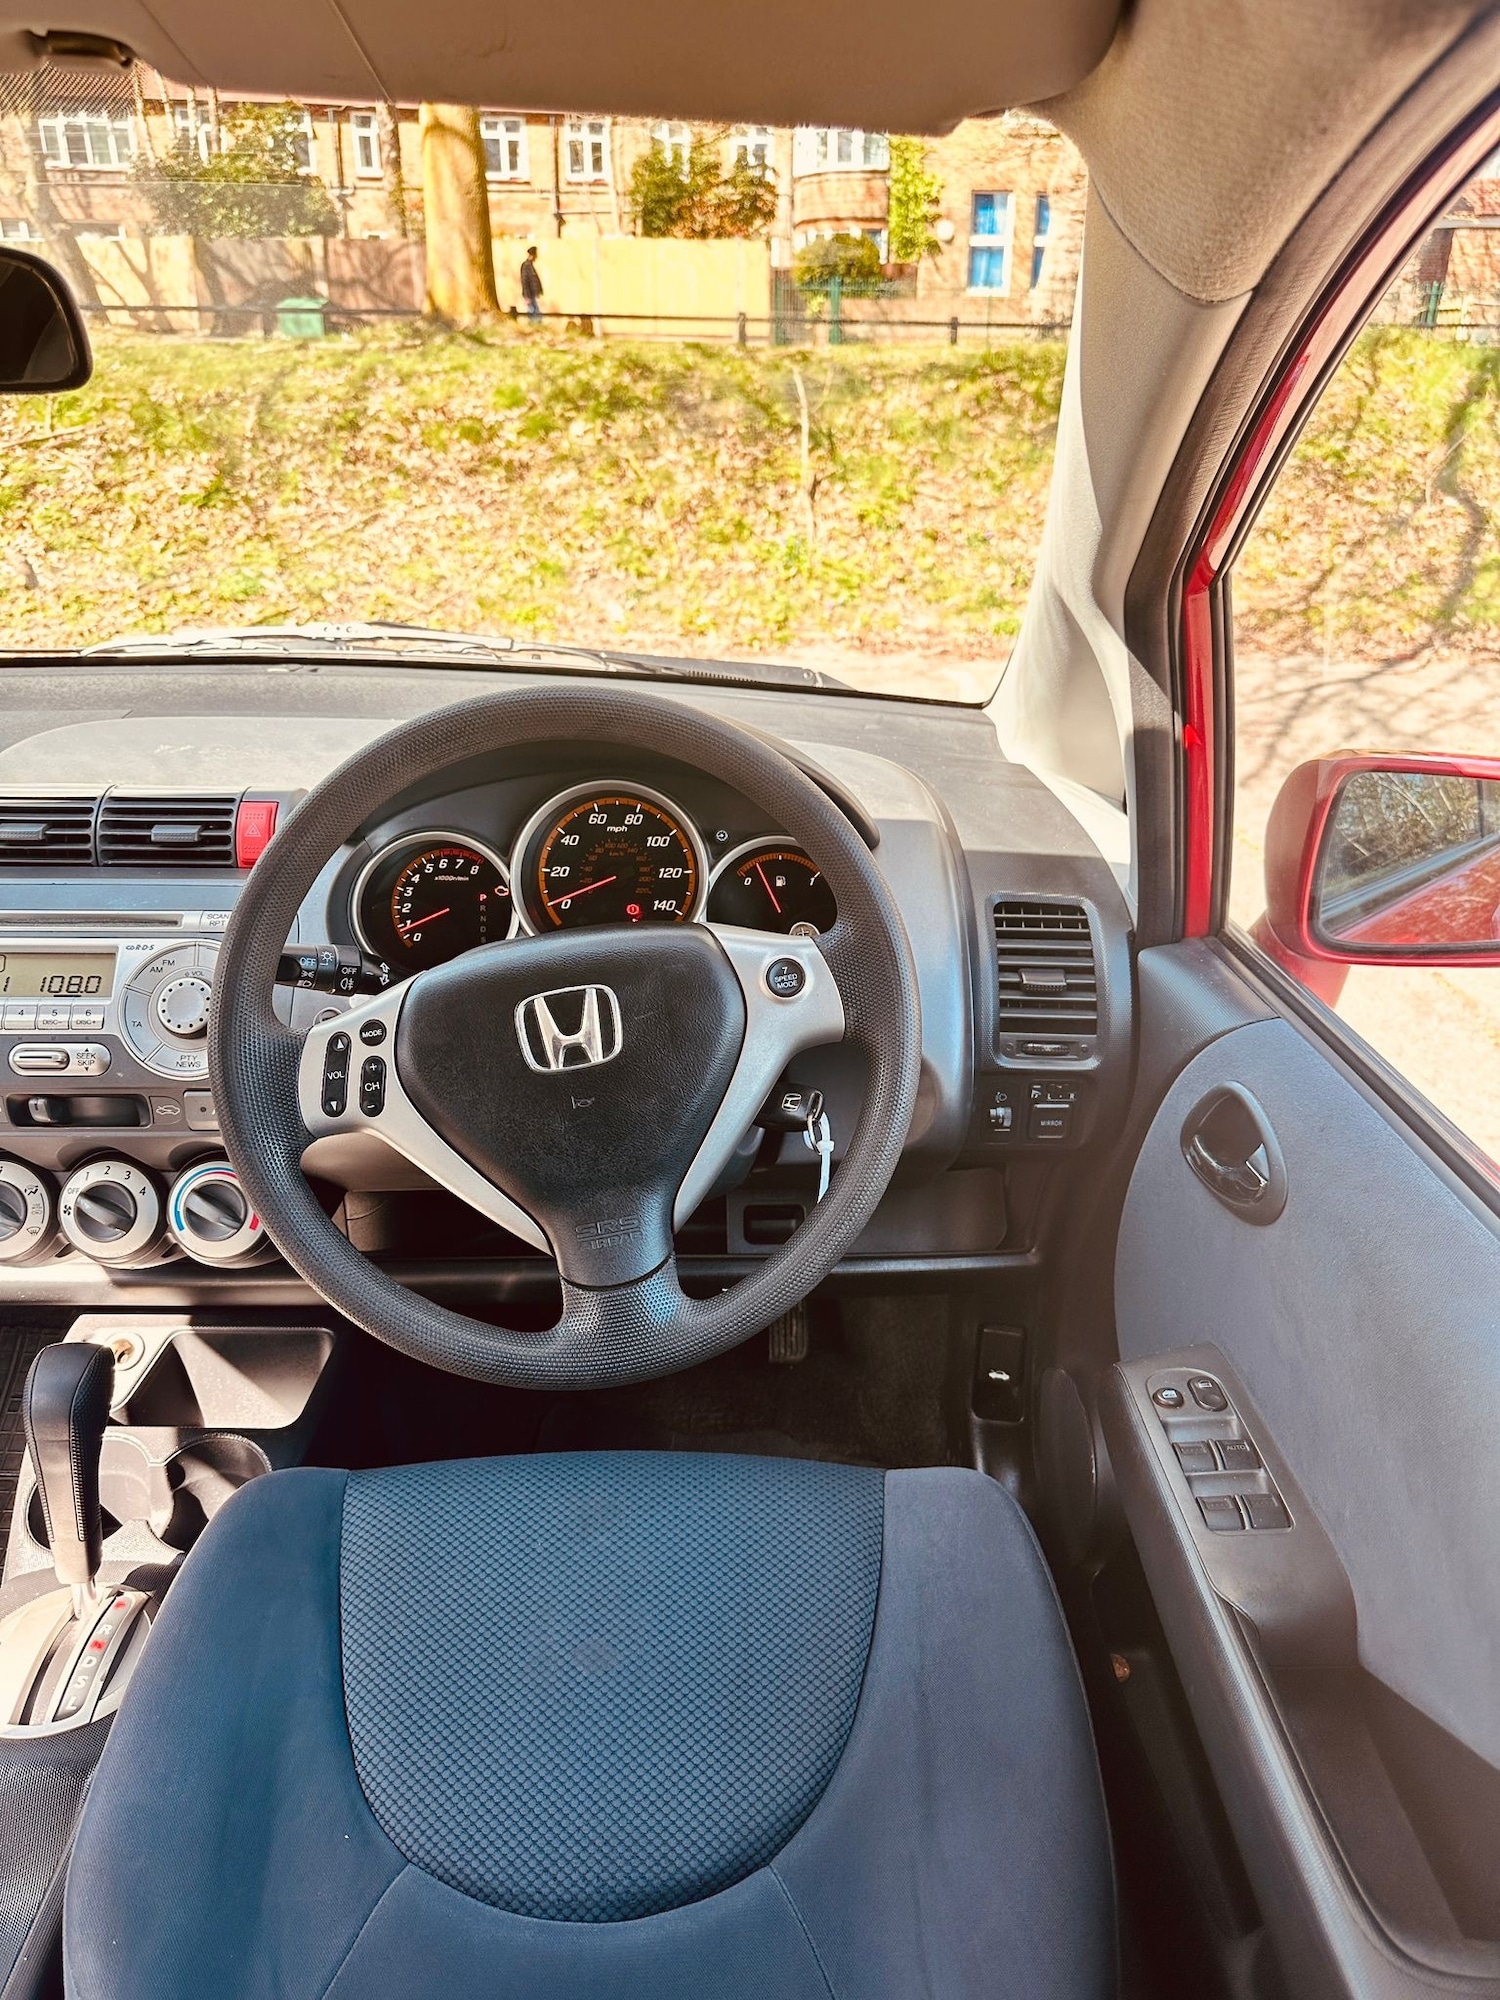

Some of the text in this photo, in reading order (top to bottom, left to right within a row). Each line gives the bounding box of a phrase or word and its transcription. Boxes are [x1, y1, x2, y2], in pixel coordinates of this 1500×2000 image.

[588, 813, 607, 824] 60
[624, 814, 643, 825] 80
[560, 834, 580, 846] 40
[646, 836, 670, 847] 100
[425, 863, 434, 873] 5
[439, 859, 448, 869] 6
[455, 859, 464, 869] 7
[470, 865, 479, 875] 8
[550, 866, 570, 877] 20
[658, 867, 683, 879] 120
[411, 874, 420, 883] 4
[744, 877, 752, 886] 0
[810, 877, 816, 886] 1
[403, 887, 414, 897] 3
[480, 893, 487, 901] P
[402, 903, 412, 913] 2
[560, 898, 571, 909] 0
[653, 900, 676, 911] 140
[413, 933, 421, 941] 0
[299, 957, 317, 966] OFF
[341, 967, 357, 975] OFF
[782, 966, 788, 974] 7
[775, 973, 798, 982] SPEED
[40, 976, 101, 993] 108.0
[777, 980, 798, 989] MODE
[362, 1029, 383, 1038] MODE
[326, 1071, 345, 1080] VOL
[364, 1082, 380, 1092] CH
[104, 1166, 111, 1174] 2
[85, 1172, 90, 1180] 1
[124, 1171, 131, 1180] 3
[139, 1186, 146, 1196] 4
[575, 1214, 640, 1238] SRS
[100, 1624, 113, 1635] R
[81, 1656, 98, 1668] D
[75, 1675, 88, 1688] S
[66, 1697, 77, 1710] L
